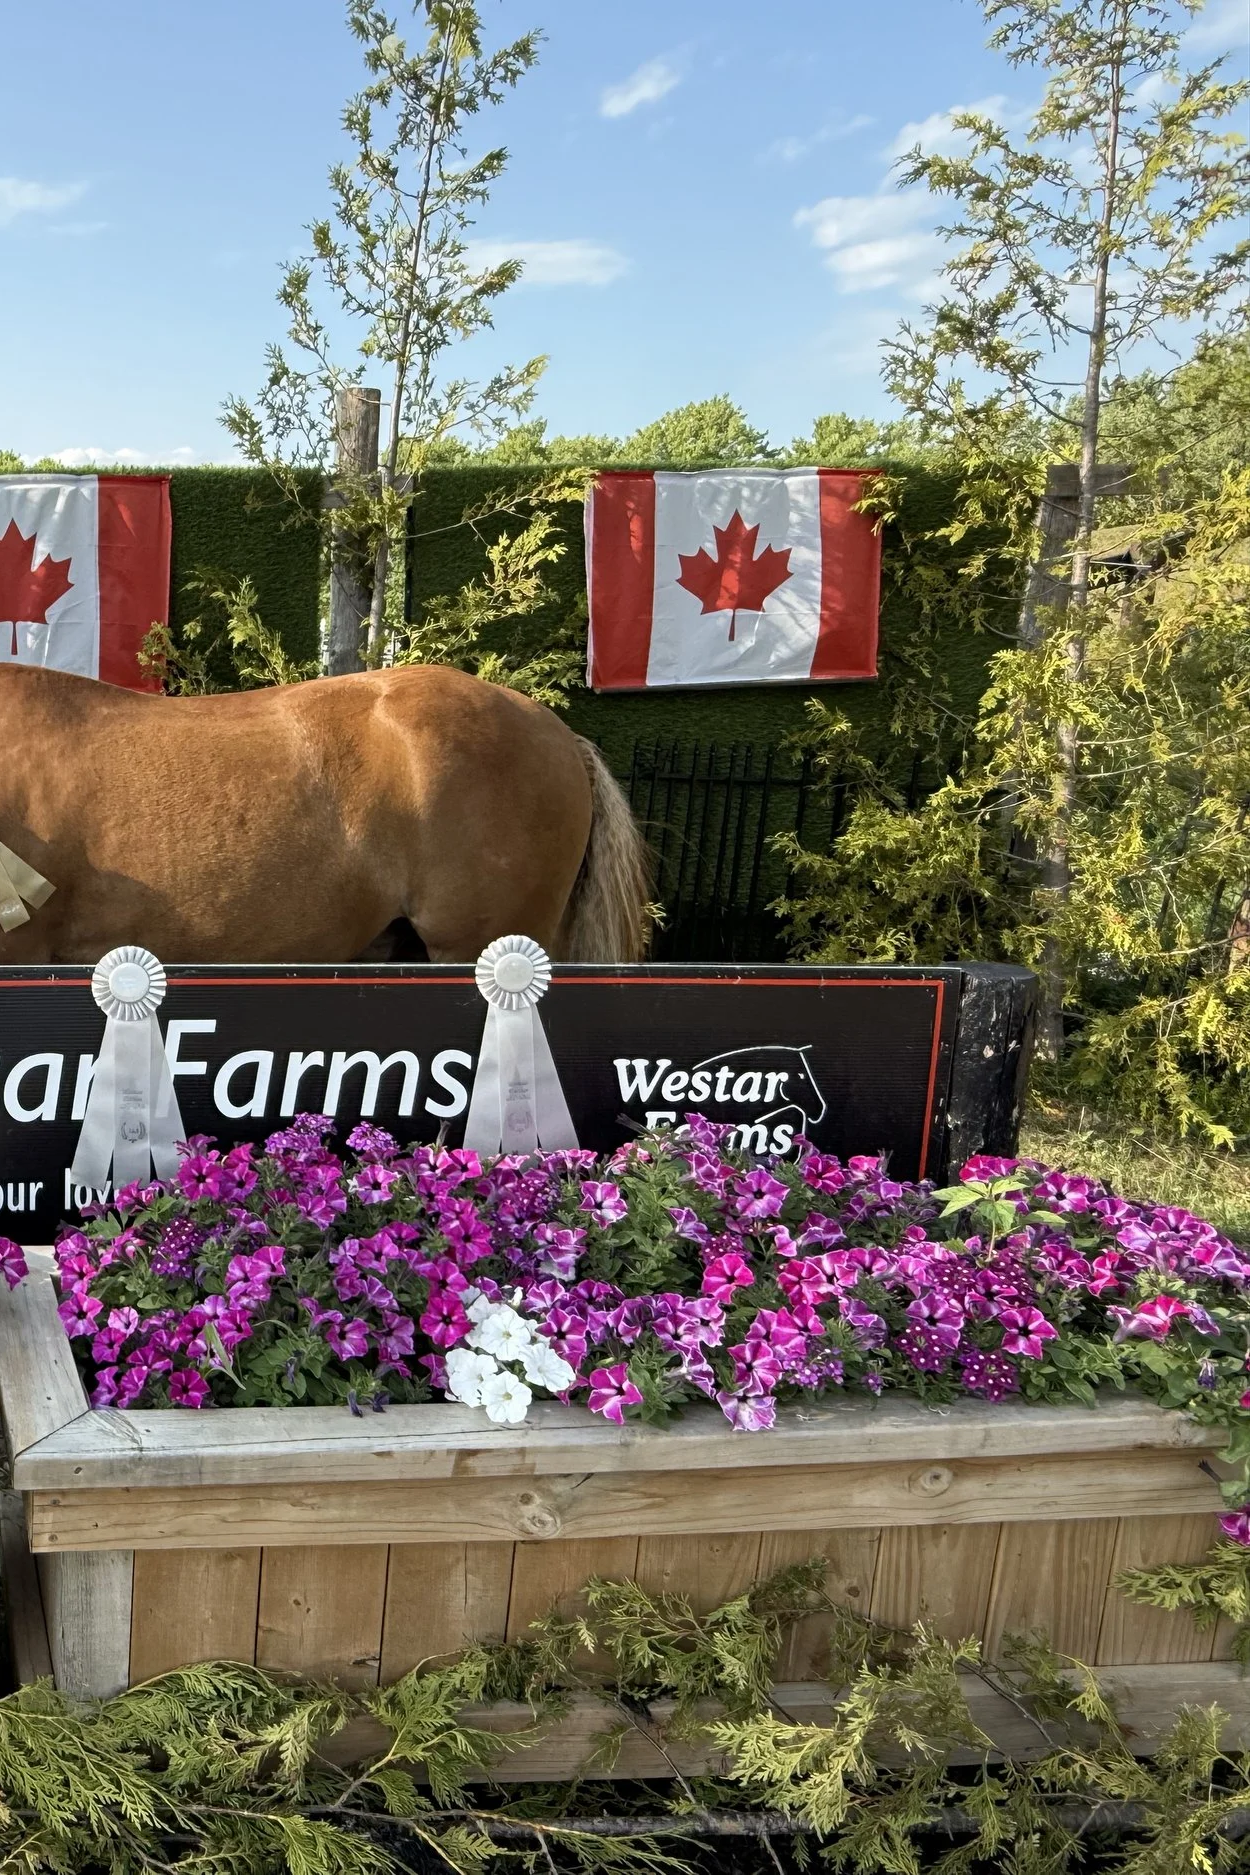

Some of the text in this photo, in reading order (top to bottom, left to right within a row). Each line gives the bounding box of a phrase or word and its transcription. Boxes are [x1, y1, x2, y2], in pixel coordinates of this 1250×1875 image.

[155, 1019, 473, 1119] Farms
[613, 1058, 789, 1103] Westar
[64, 1167, 119, 1210] lov
